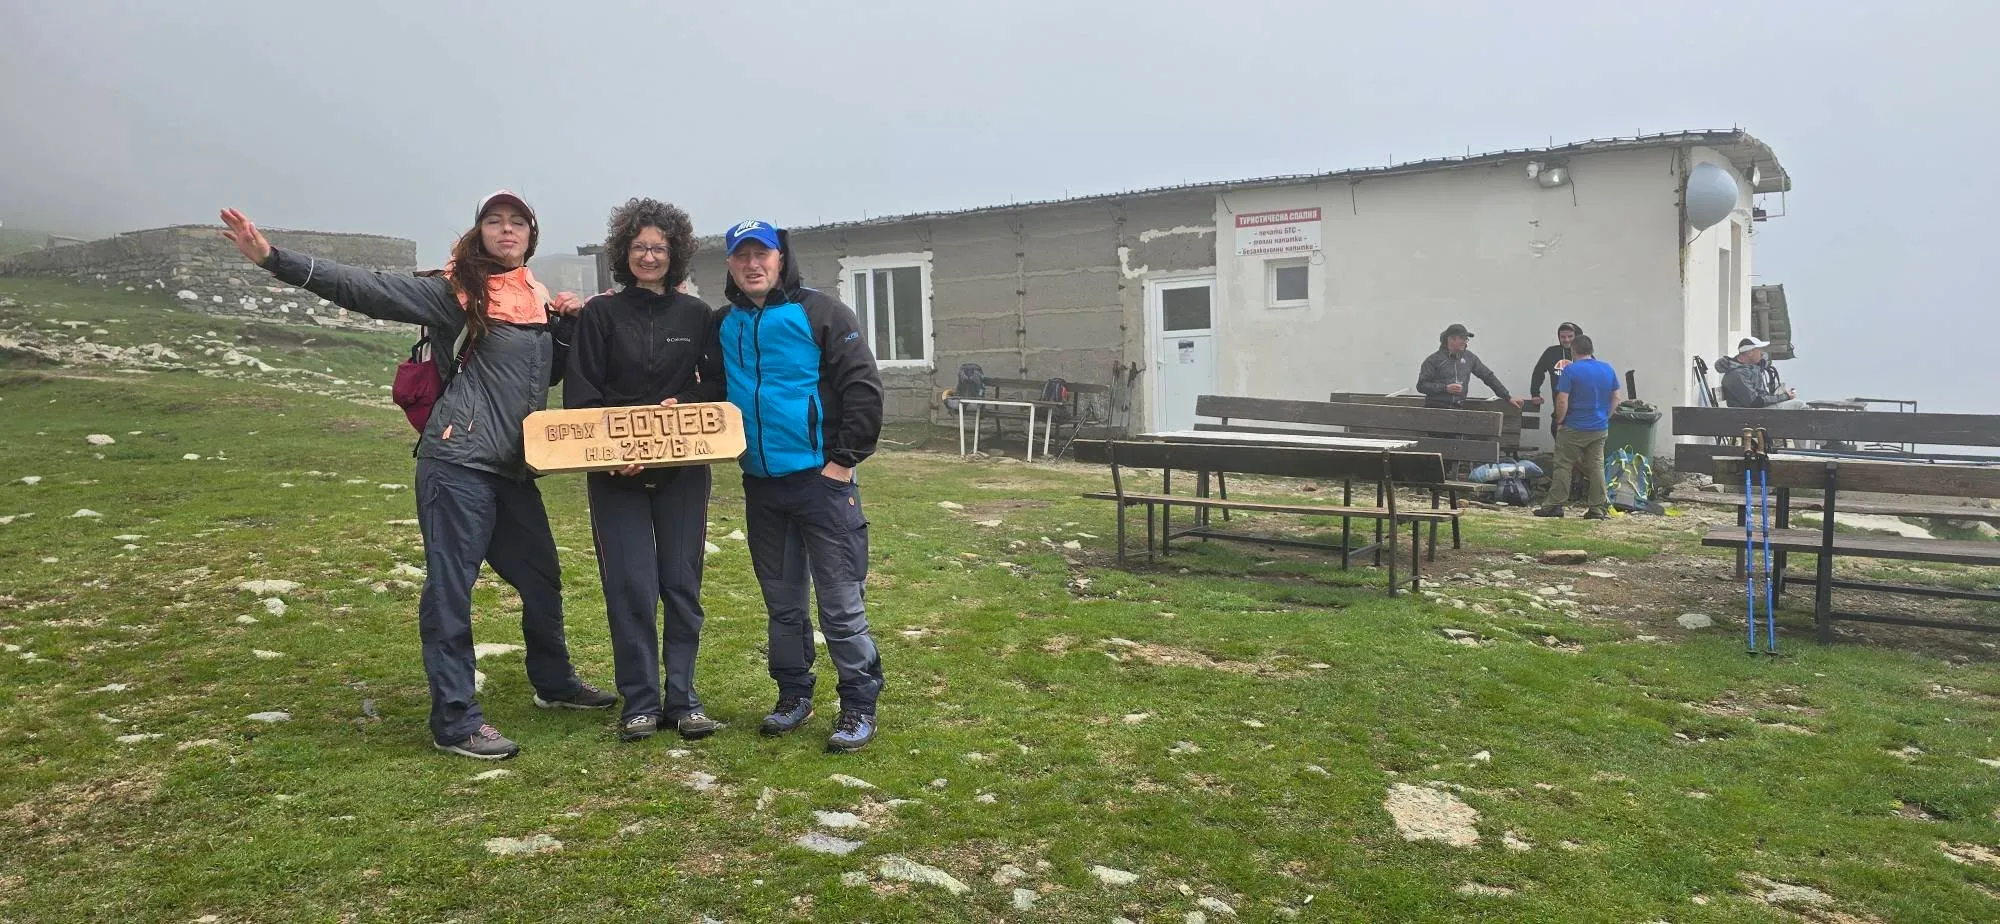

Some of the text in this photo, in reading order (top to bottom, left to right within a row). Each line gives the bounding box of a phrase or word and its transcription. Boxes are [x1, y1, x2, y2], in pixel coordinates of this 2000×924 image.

[545, 406, 724, 441] ВРЪХ БОТЕВ
[621, 438, 687, 461] 2376
